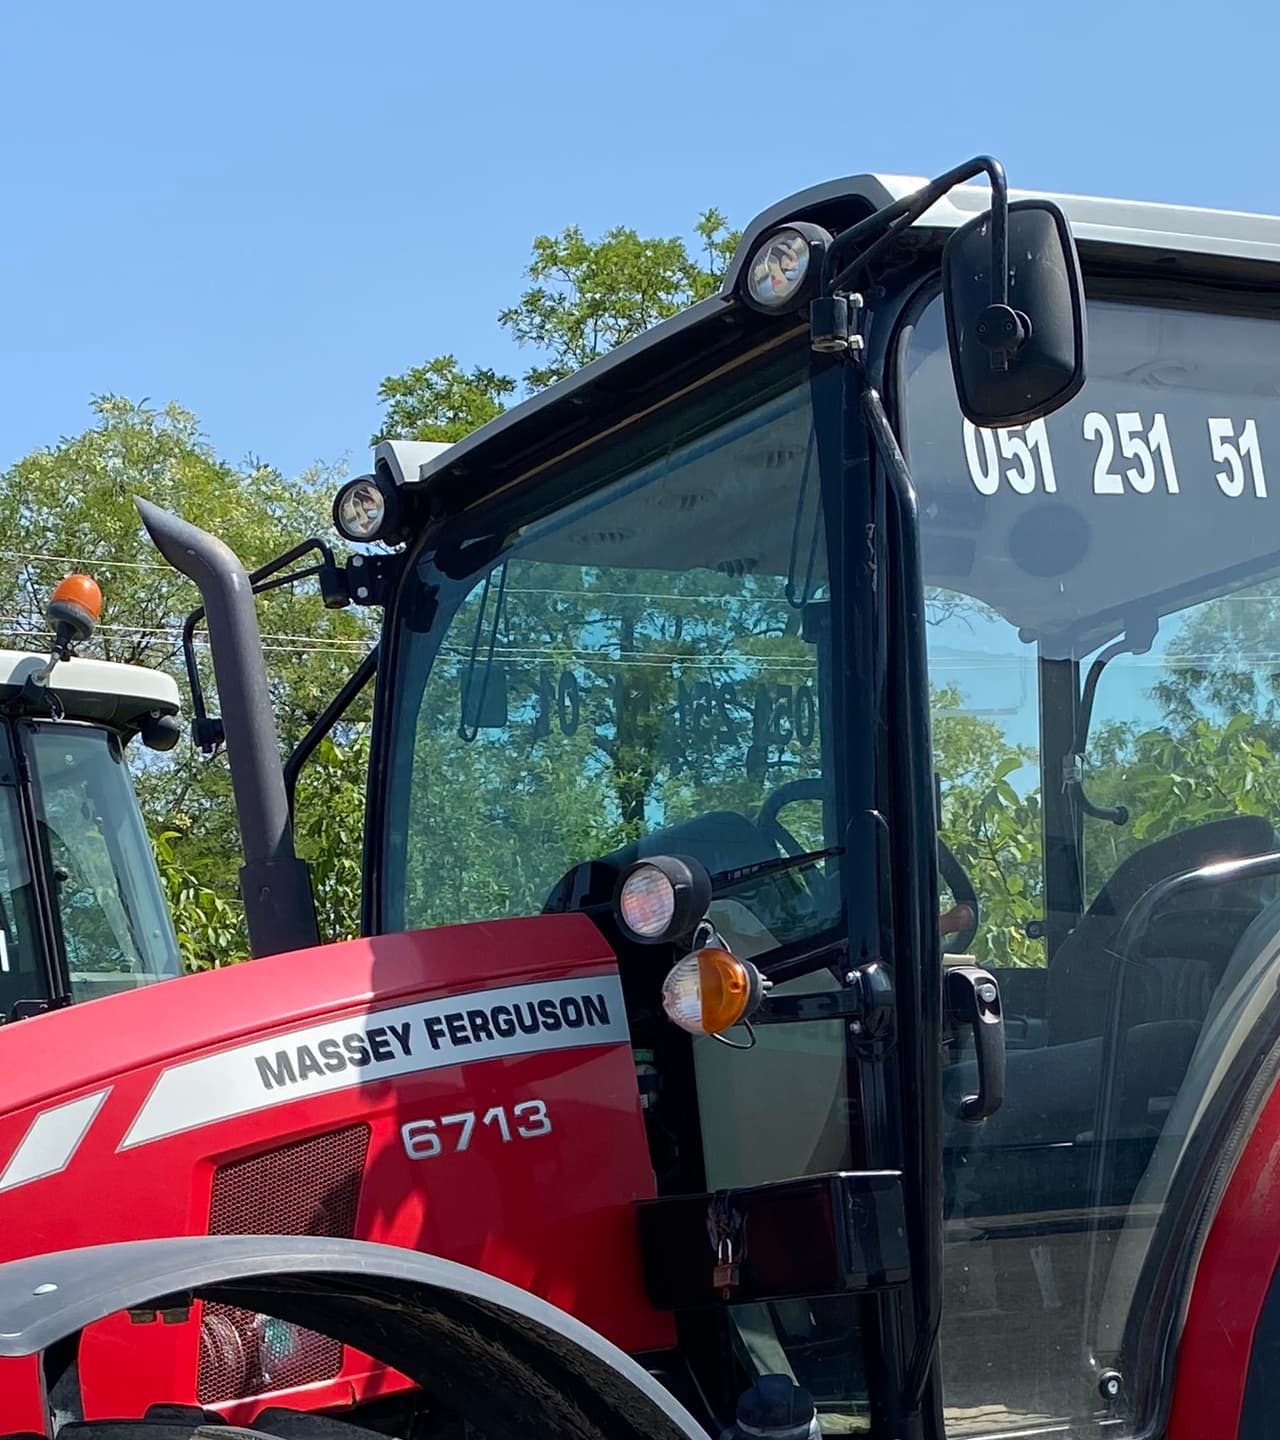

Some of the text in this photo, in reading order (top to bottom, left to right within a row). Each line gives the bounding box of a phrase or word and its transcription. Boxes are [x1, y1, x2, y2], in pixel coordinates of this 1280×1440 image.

[963, 416, 1057, 495] 051
[1083, 412, 1180, 495] 251
[1207, 417, 1268, 498] 51
[255, 993, 610, 1090] MASSEY FERGUSON
[401, 1099, 552, 1160] 6713
